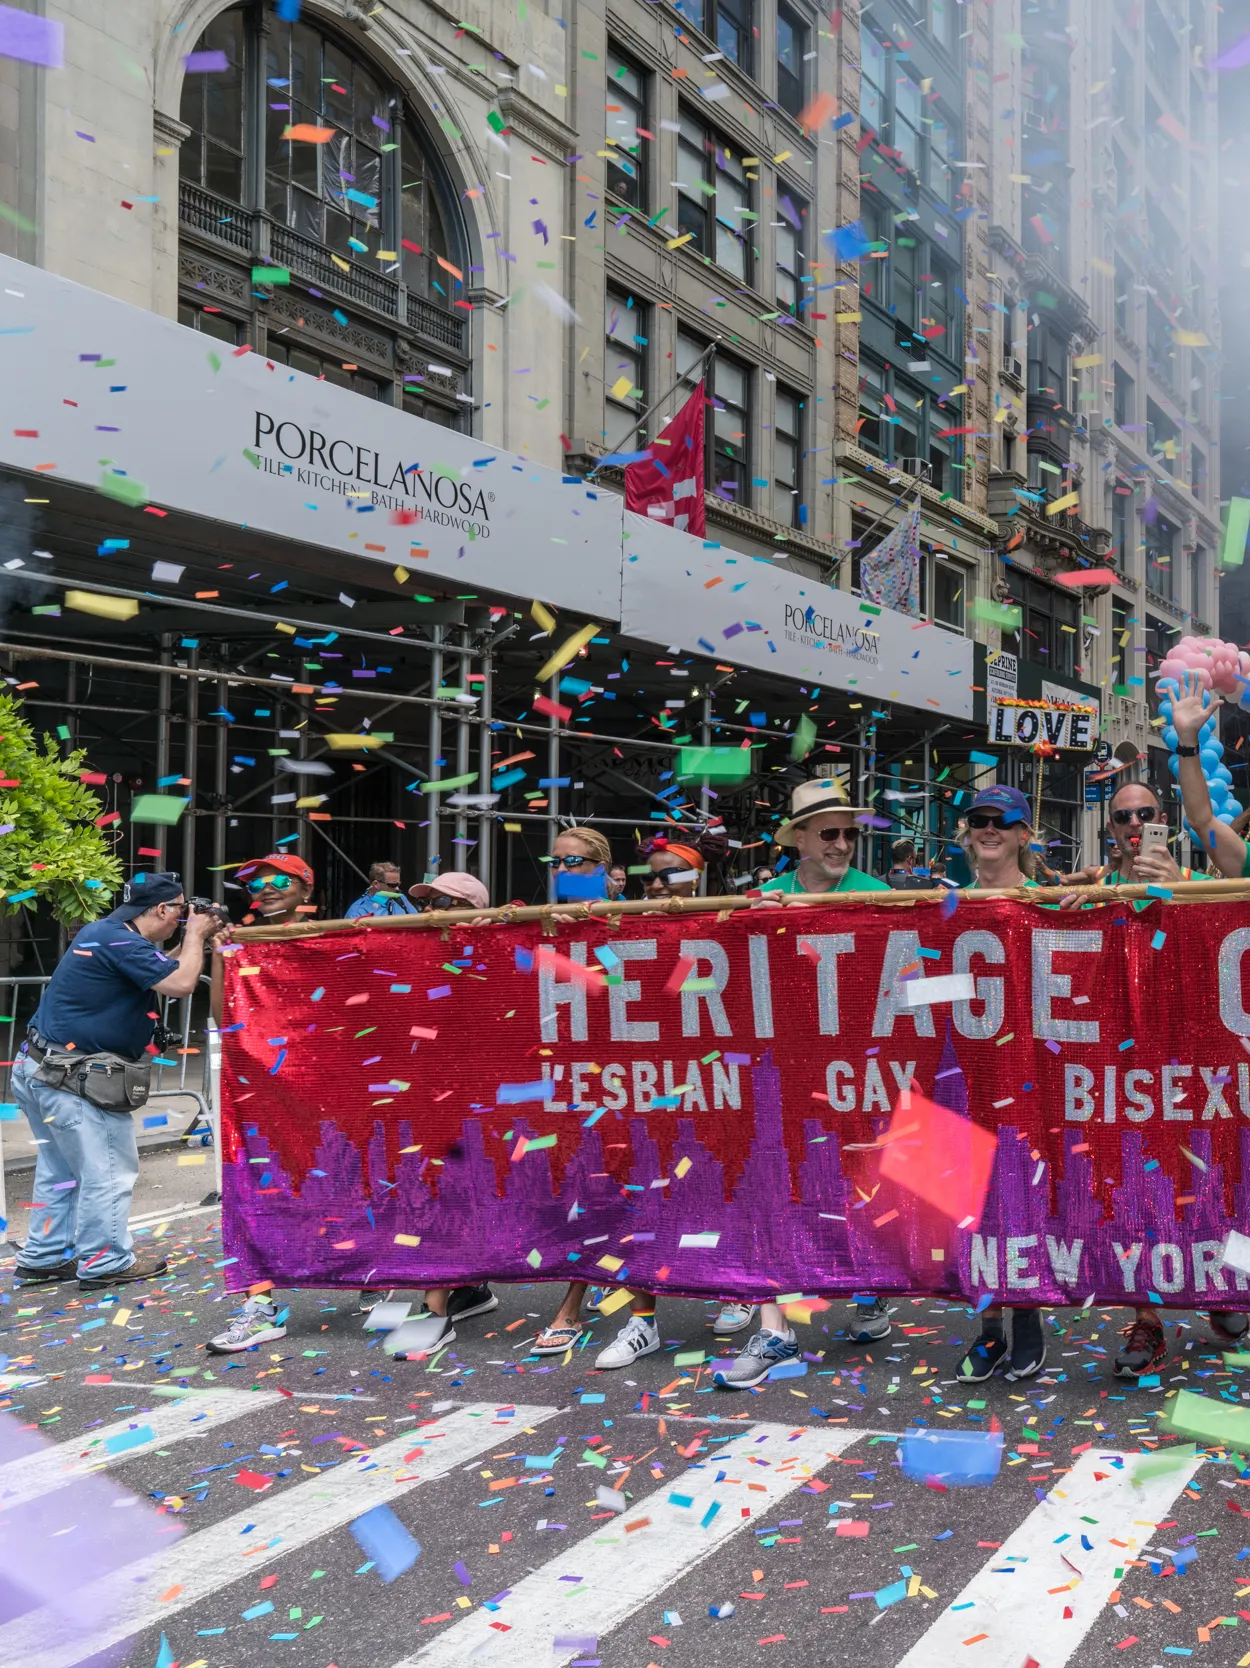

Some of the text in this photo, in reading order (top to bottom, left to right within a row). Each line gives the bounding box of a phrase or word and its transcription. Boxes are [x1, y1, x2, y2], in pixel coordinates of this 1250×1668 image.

[253, 454, 491, 538] TILE KITCHEN BATH HARDWOOD
[801, 635, 825, 649] KITCH
[988, 650, 1017, 673] PRINE
[995, 708, 1090, 748] LOVE
[537, 929, 1103, 1043] HERITAGE
[541, 1059, 742, 1112] LESBIAN
[825, 1057, 917, 1112] GAY
[971, 1232, 1084, 1289] NEW
